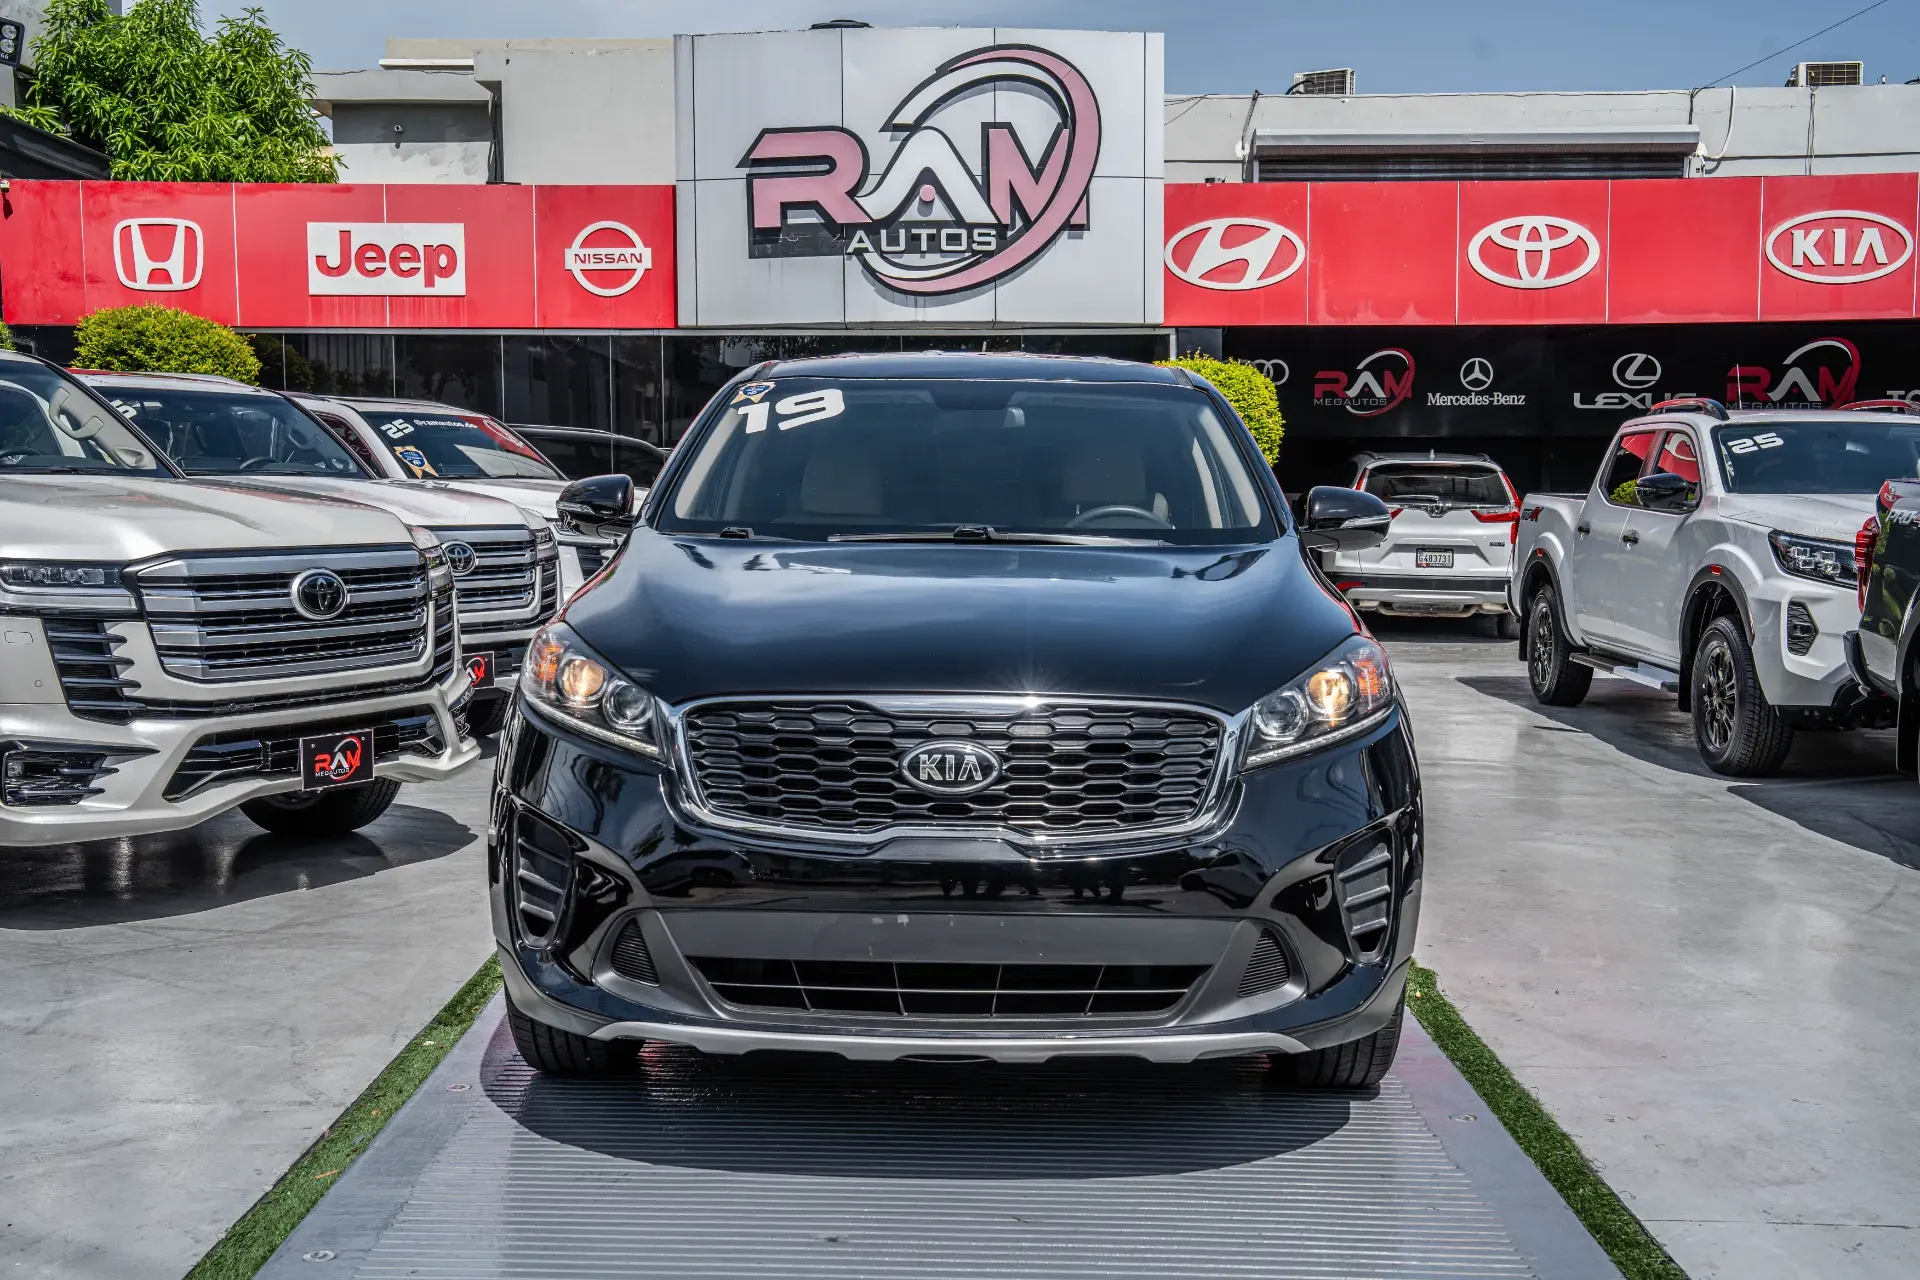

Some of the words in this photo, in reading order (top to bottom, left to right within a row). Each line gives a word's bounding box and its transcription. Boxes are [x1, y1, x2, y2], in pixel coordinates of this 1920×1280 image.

[738, 123, 1090, 232] RAM
[847, 228, 997, 254] AUTOS
[1791, 227, 1889, 267] KIA
[315, 230, 458, 288] Jeep
[573, 251, 643, 265] NISSAN
[1313, 370, 1413, 398] RAM
[1726, 366, 1856, 402] RAM
[737, 388, 846, 434] 19
[1313, 398, 1387, 406] MEGAUTOS
[1427, 392, 1526, 406] Mercedes-Benz
[1726, 402, 1822, 411] MEGAUTOS
[380, 418, 415, 439] 25
[1727, 432, 1784, 454] 25
[918, 754, 983, 781] KIA
